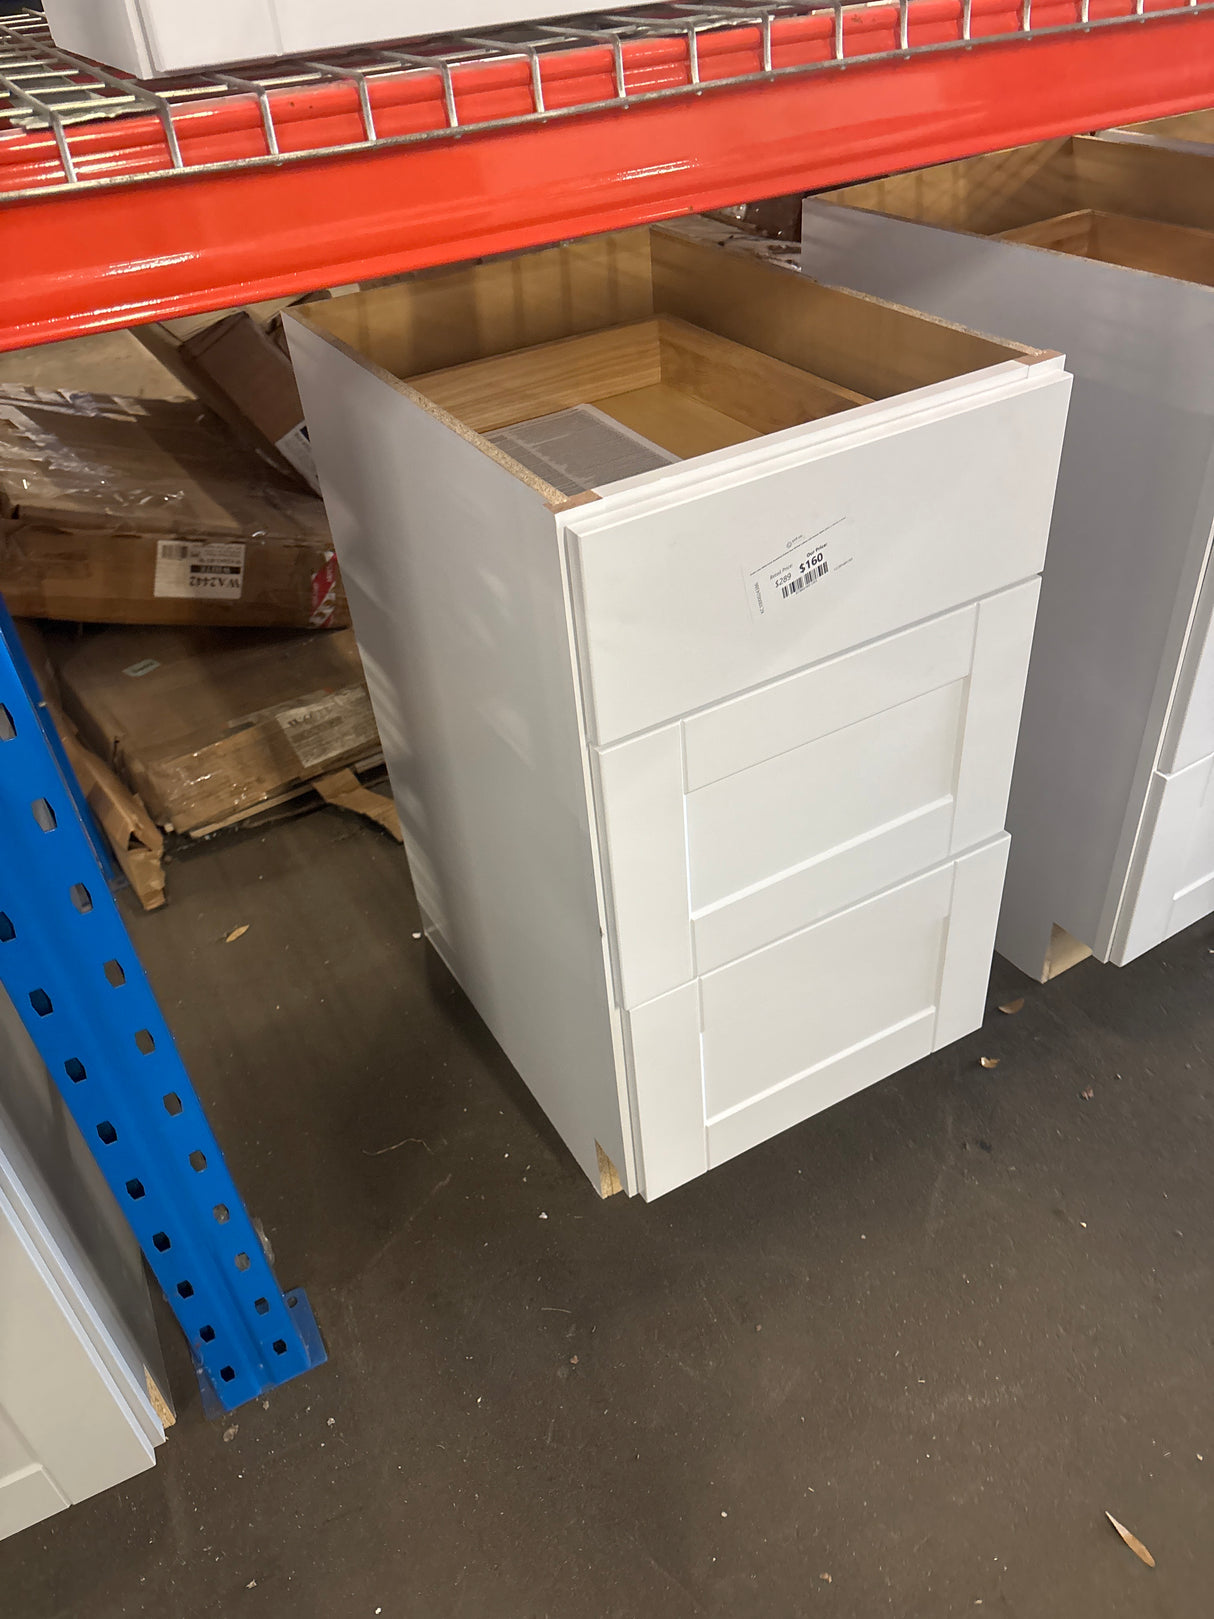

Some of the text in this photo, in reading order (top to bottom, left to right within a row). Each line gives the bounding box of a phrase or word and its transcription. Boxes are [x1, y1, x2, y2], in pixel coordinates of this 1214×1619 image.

[799, 553, 824, 573] $160
[189, 576, 240, 588] WA2442
[775, 573, 792, 588] $289
